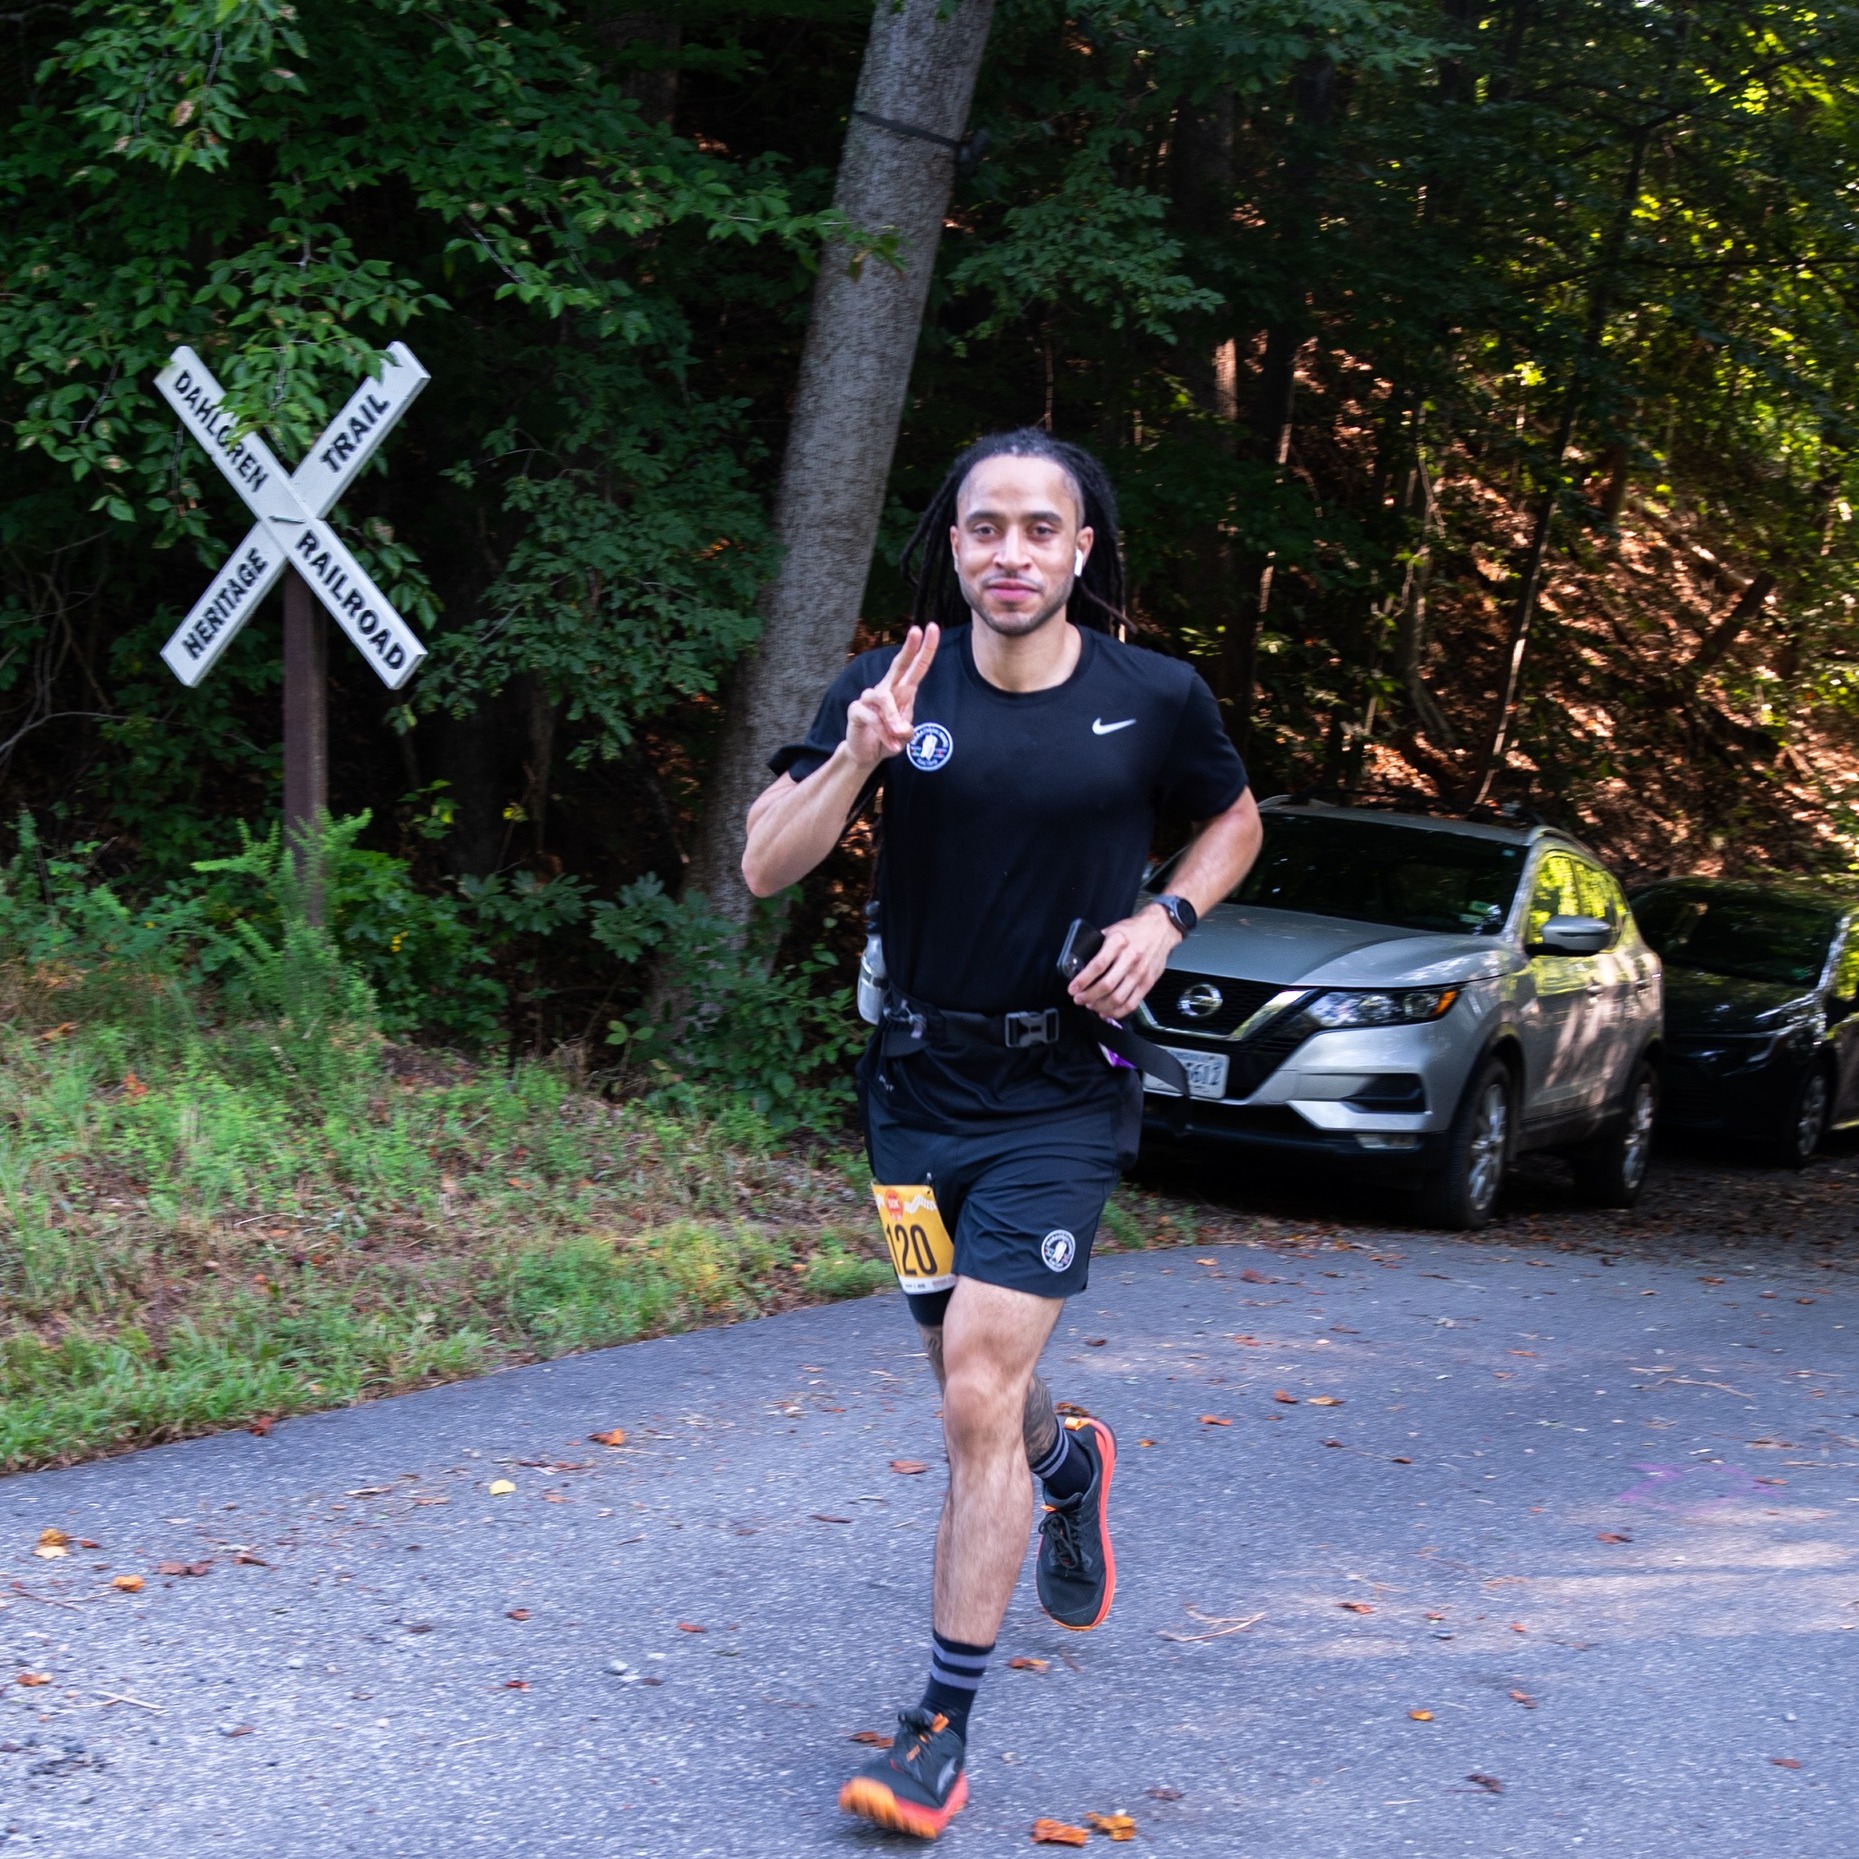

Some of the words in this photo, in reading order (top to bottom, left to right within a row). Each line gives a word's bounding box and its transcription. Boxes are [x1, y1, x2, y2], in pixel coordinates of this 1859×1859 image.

[180, 547, 269, 660] HERITAGE
[320, 394, 391, 473] TRAIL
[295, 529, 407, 670] RAILROAD
[886, 1222, 938, 1277] 120
